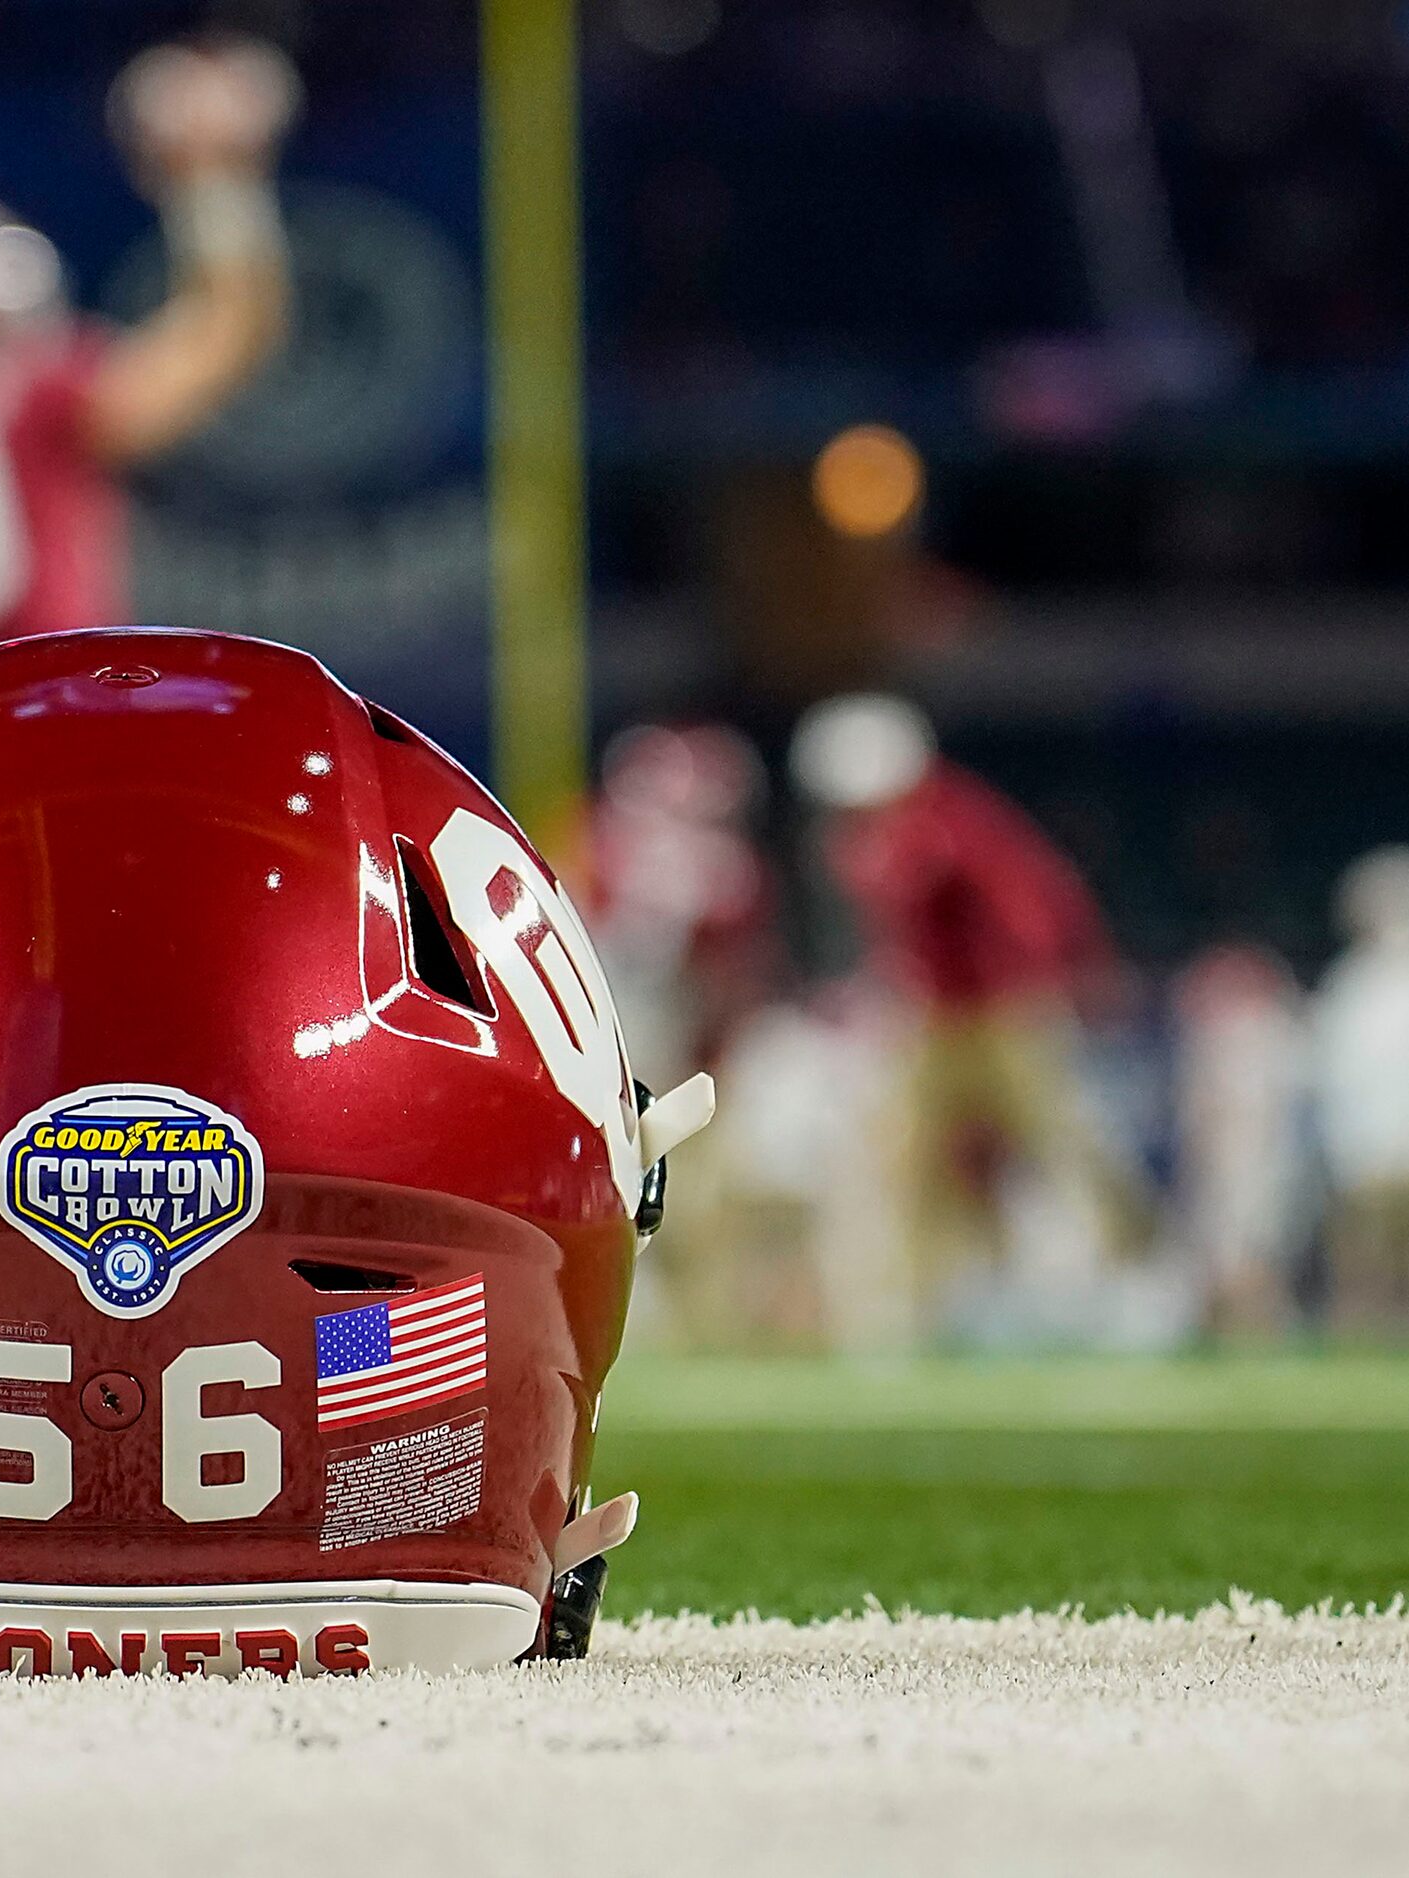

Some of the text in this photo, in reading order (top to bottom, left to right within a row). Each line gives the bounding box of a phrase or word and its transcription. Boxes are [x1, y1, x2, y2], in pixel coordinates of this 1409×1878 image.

[26, 1157, 233, 1220] COTTON
[65, 1196, 194, 1233] BOWL
[94, 1227, 164, 1256] CLASSIC
[95, 1278, 162, 1302] EST. 1937
[161, 1340, 282, 1524] 6
[370, 1425, 450, 1455] WARNING
